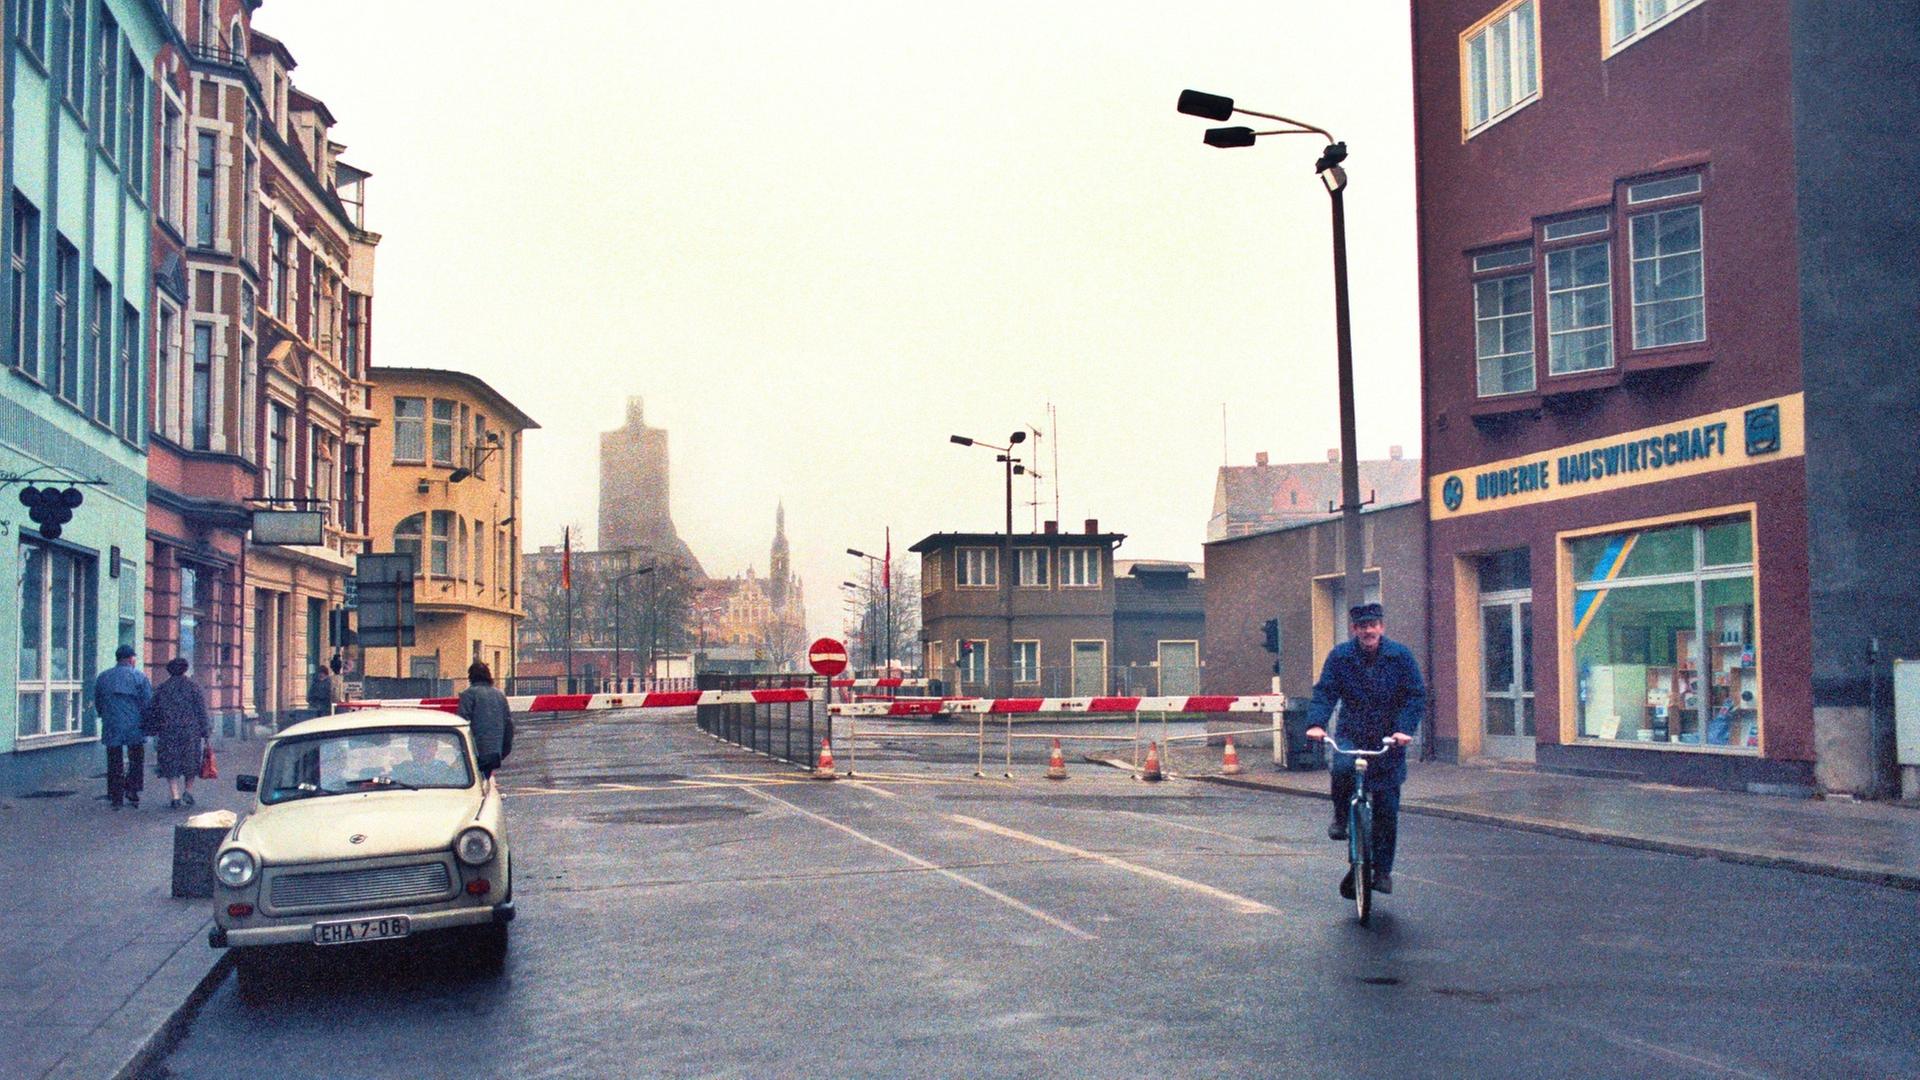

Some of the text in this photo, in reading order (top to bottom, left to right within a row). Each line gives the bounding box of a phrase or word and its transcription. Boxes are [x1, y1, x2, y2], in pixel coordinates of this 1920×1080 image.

[1476, 460, 1549, 500] MODERNE
[1558, 421, 1727, 486] HAUSWIRTSCHAFT
[322, 924, 354, 941] EHA
